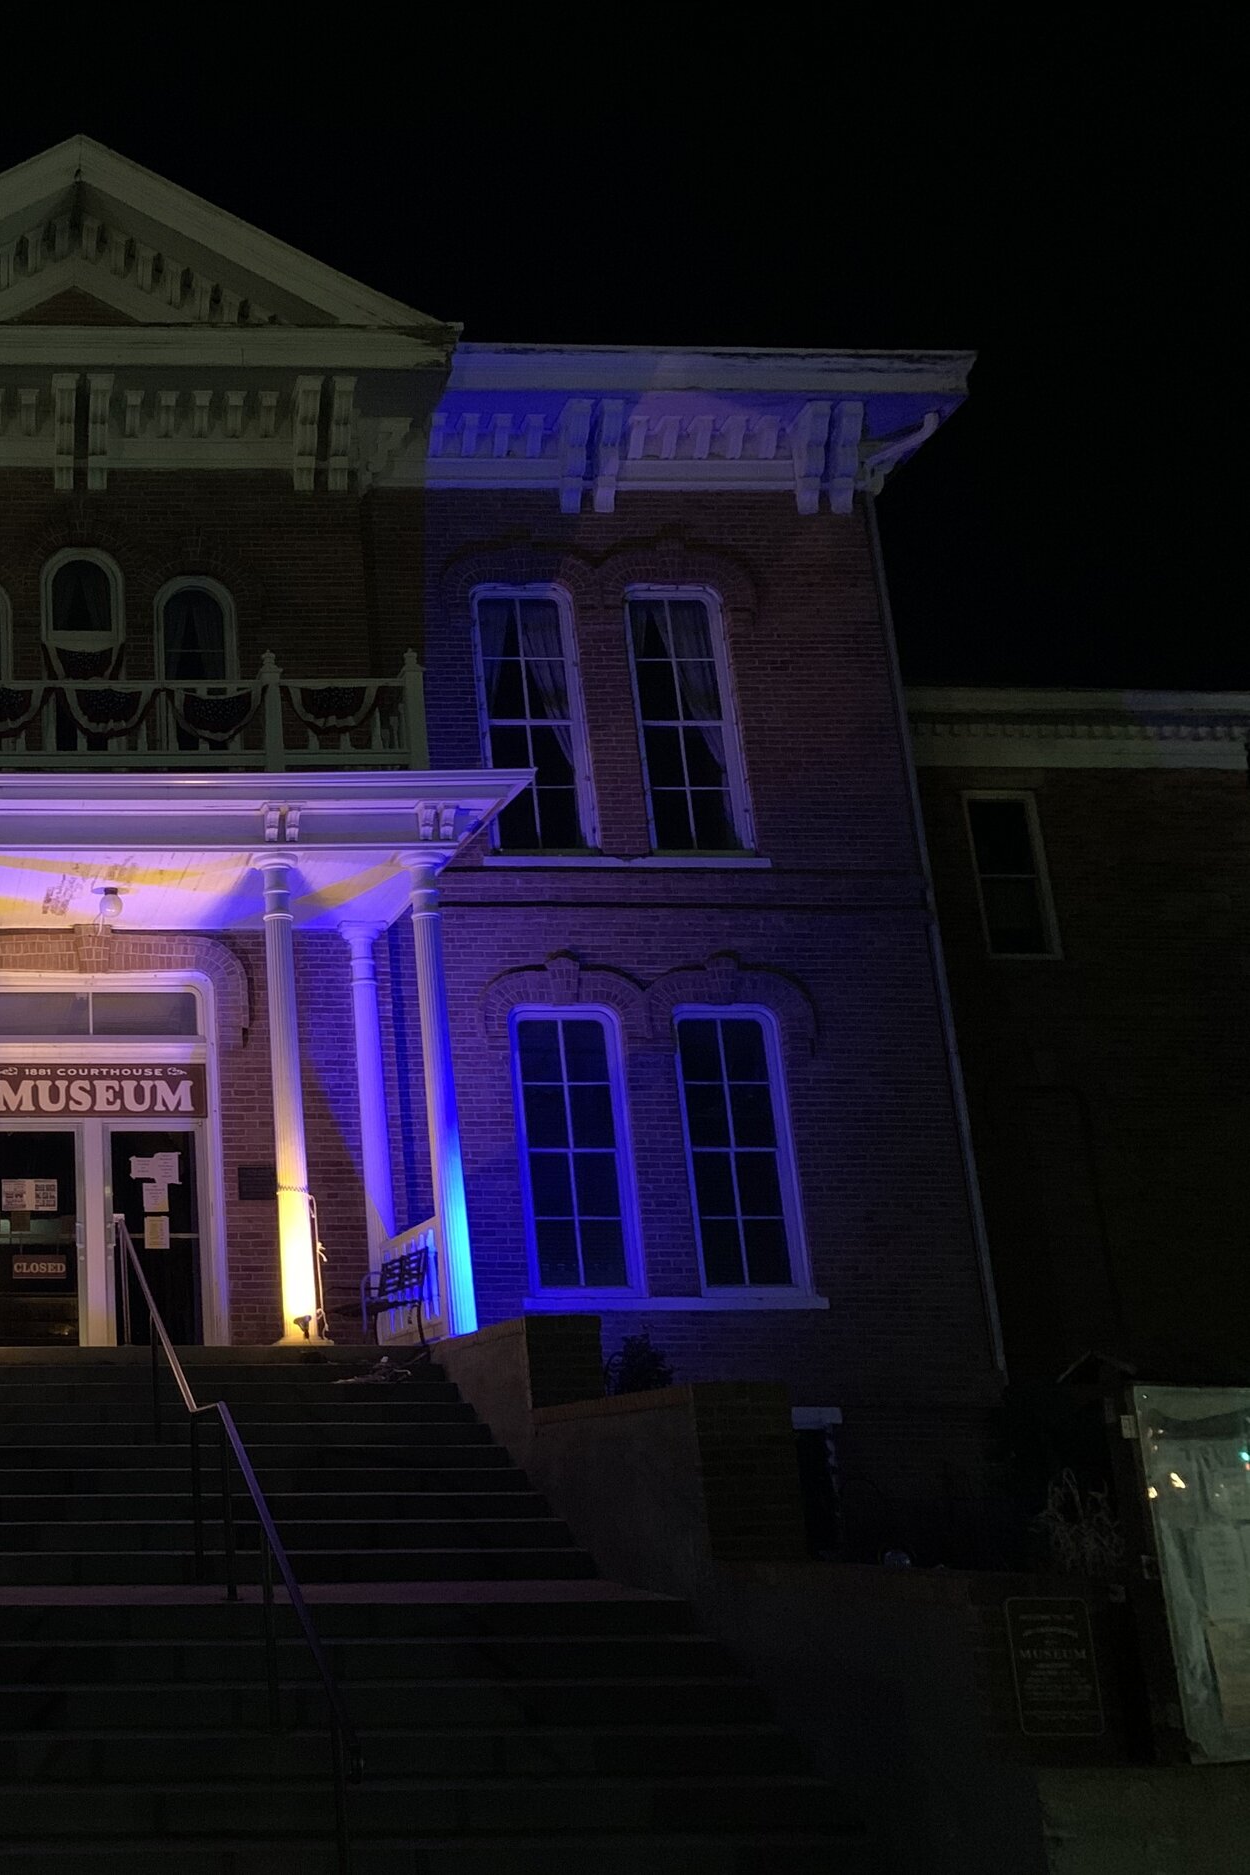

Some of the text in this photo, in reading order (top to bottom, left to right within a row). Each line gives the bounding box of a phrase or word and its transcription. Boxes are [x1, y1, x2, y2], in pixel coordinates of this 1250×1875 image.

[24, 1068, 164, 1076] 1881 COURTHOUSE
[13, 1262, 66, 1273] CLOSED
